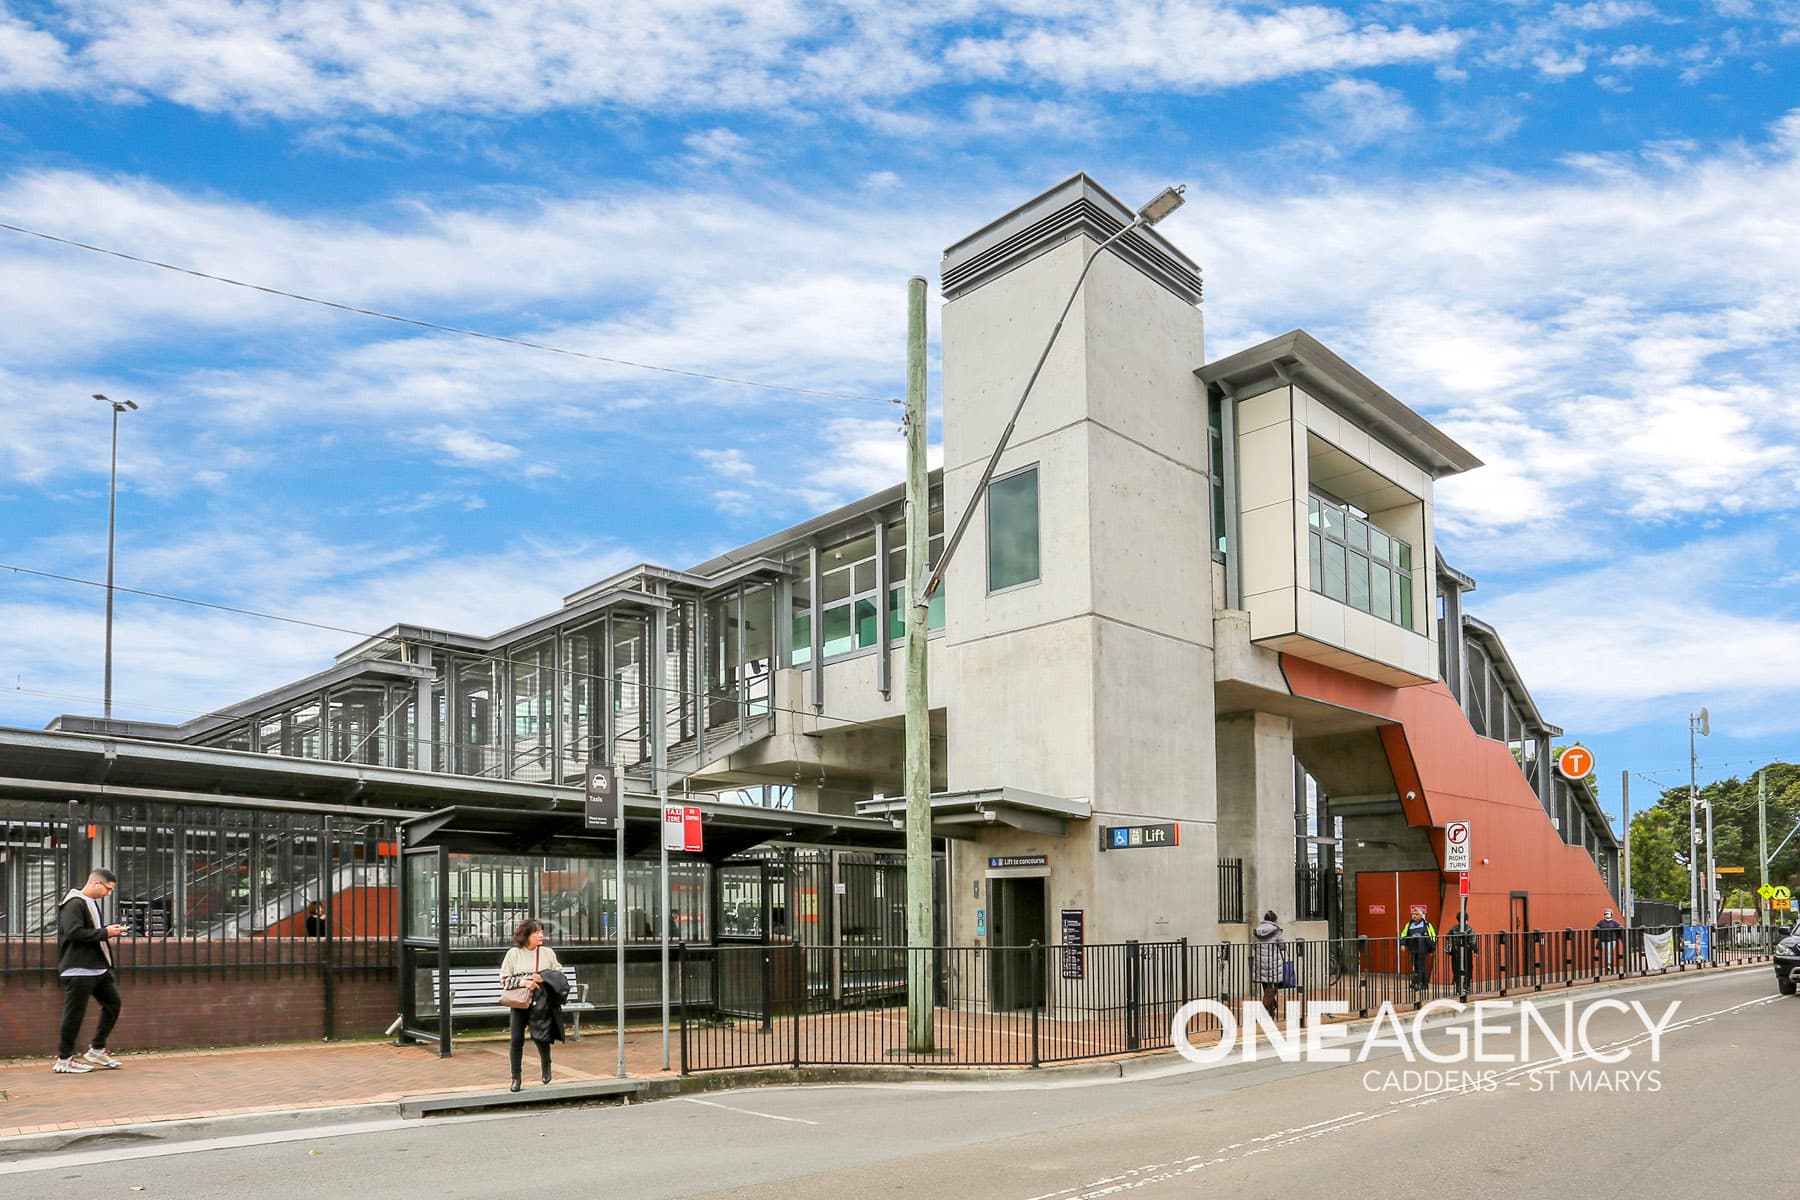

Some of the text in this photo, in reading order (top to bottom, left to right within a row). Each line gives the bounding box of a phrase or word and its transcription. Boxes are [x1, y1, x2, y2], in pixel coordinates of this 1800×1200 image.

[1569, 755, 1583, 772] T
[667, 815, 682, 823] ZONE
[1145, 829, 1166, 843] Lift
[1451, 846, 1465, 854] NO
